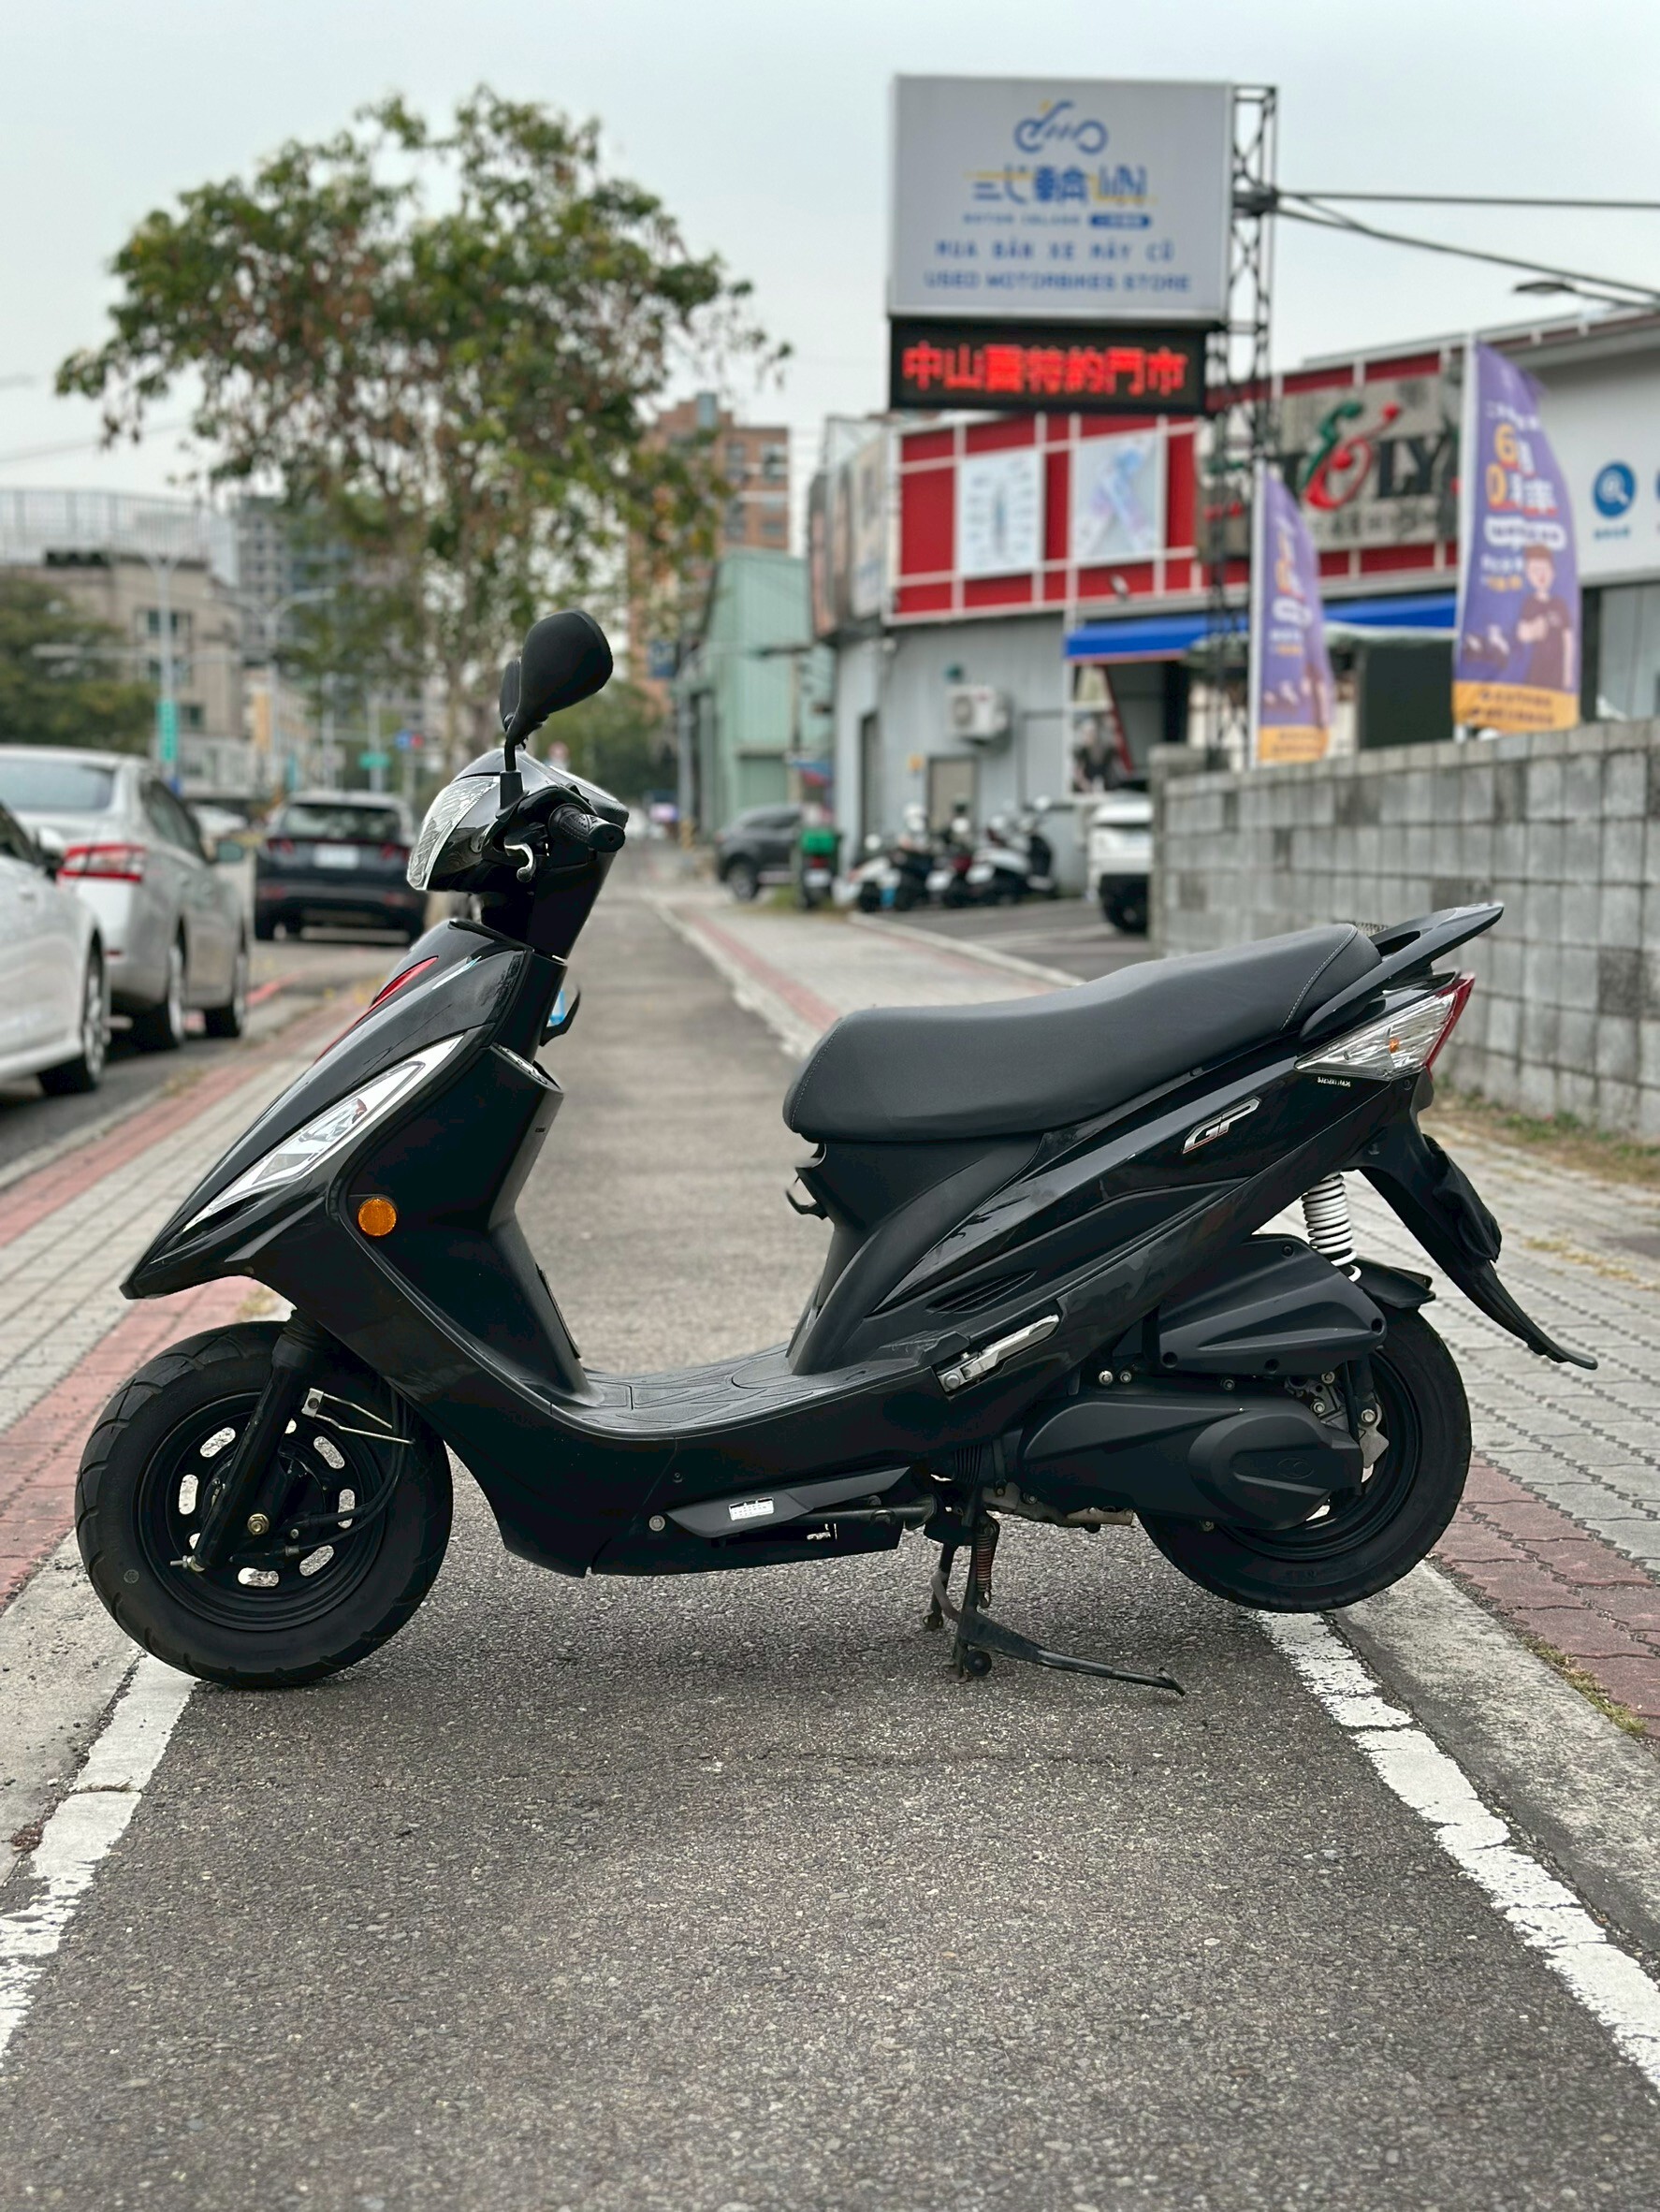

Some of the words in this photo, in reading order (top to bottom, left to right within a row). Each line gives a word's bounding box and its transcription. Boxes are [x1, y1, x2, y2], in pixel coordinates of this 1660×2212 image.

[925, 269, 980, 289] USED
[986, 270, 1116, 292] MOTORBIKES
[1119, 273, 1190, 293] STORE
[1182, 1097, 1260, 1155] GP
